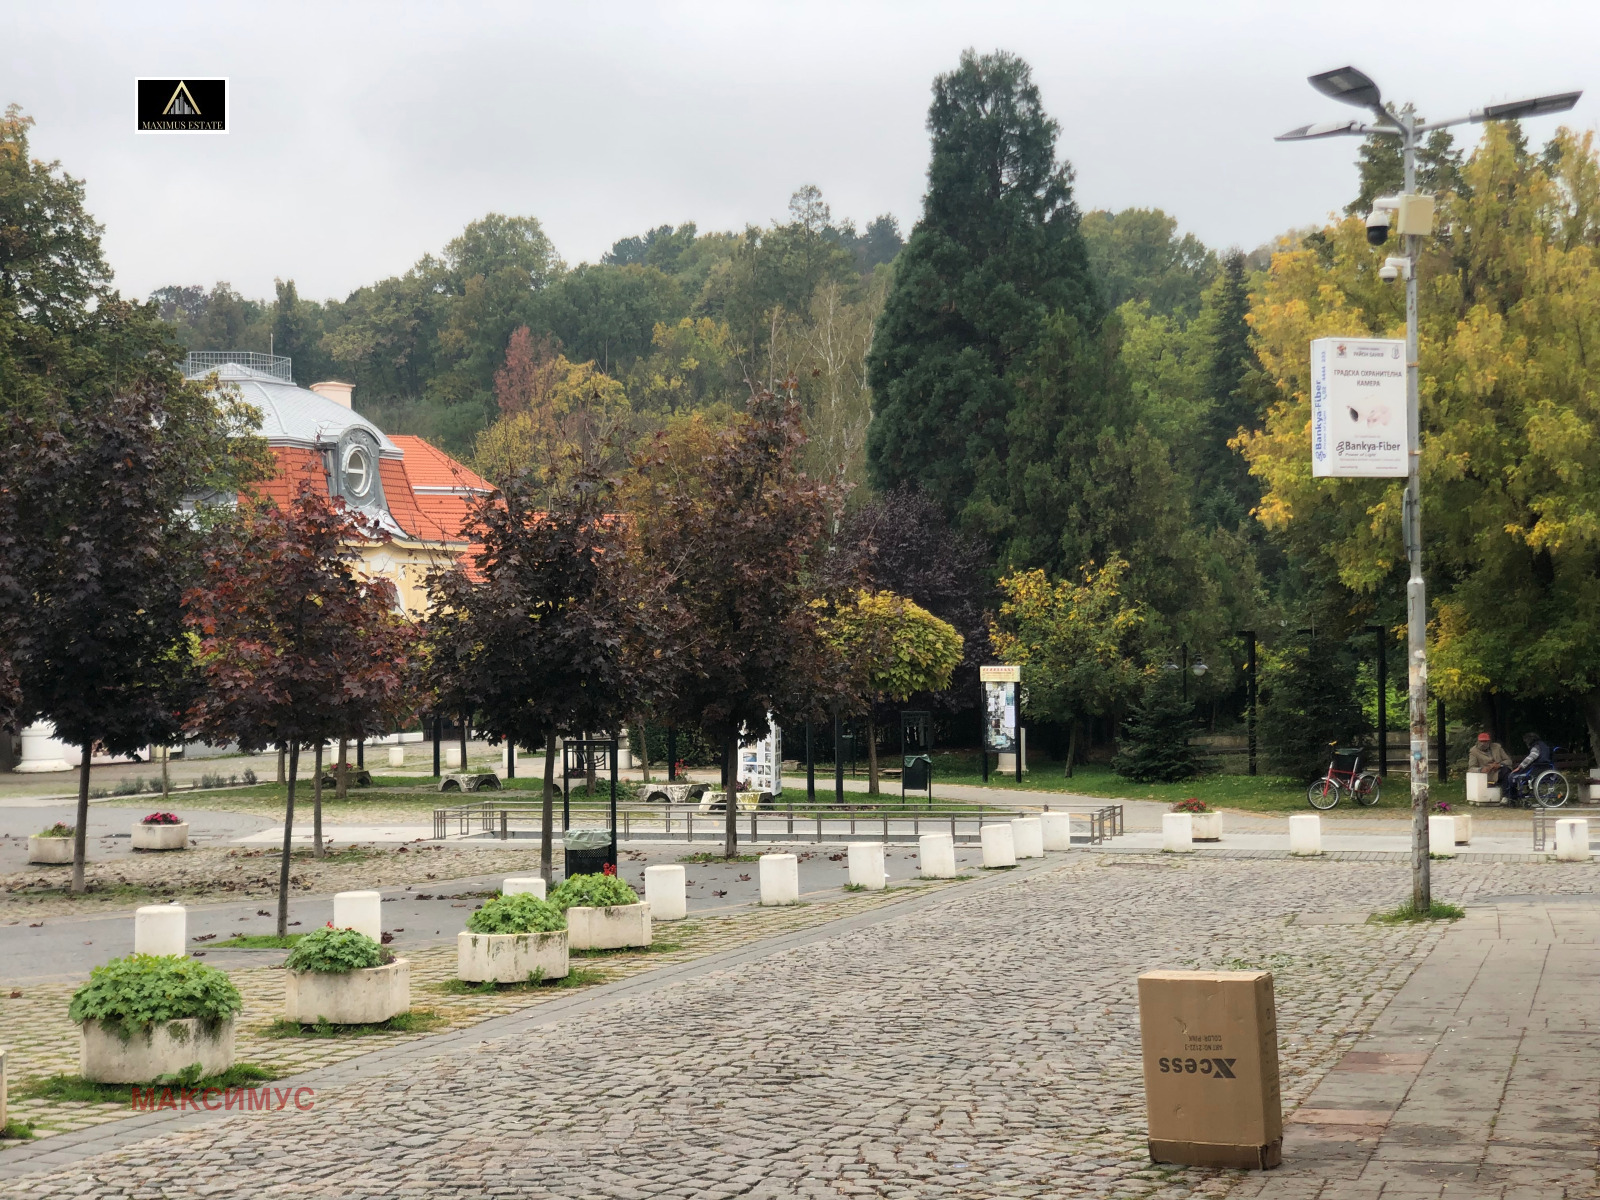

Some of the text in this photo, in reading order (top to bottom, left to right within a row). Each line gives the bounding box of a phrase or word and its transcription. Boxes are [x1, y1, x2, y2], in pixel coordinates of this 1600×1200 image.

[1334, 369, 1403, 378] ГРАДСКА ОХРАНИТЕЛНА
[1315, 381, 1323, 450] Bankya-Fiber
[1345, 441, 1401, 452] Bankya-Fiber
[1159, 1057, 1237, 1079] Xcess
